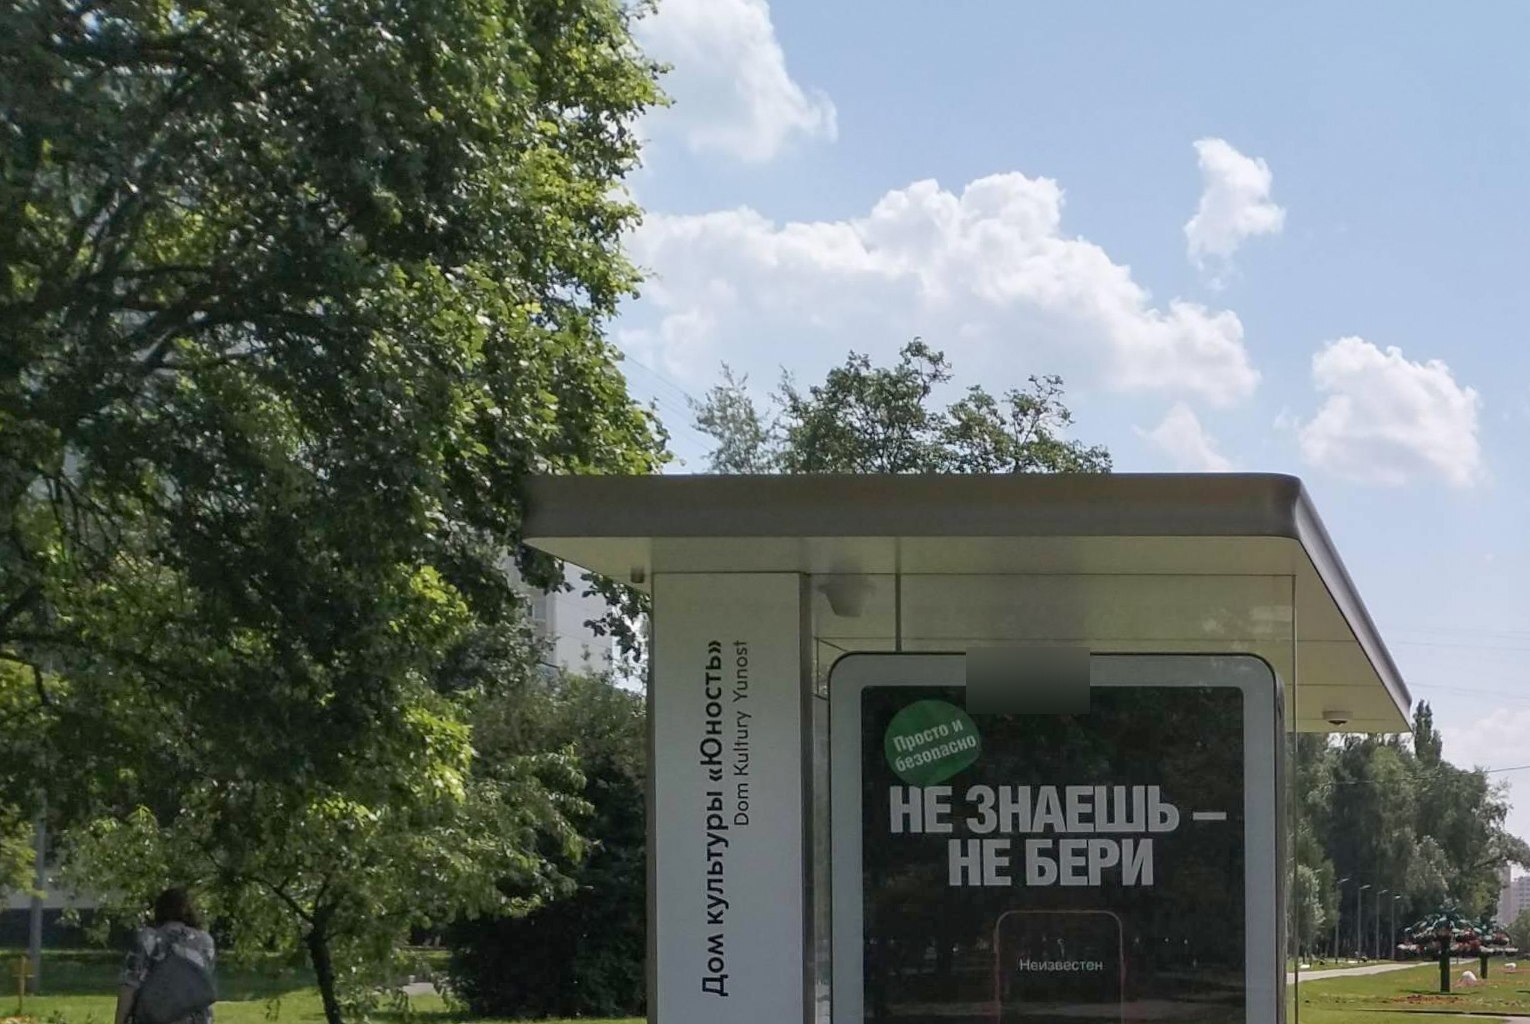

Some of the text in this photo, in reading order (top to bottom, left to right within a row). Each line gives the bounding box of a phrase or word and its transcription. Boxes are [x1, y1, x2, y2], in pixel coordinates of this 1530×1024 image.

[733, 639, 752, 826] Dom Kultury Yunost
[893, 719, 964, 752] Просто и
[895, 735, 977, 772] безопасно
[700, 640, 730, 997] Дом культуры «Юность»
[889, 785, 953, 834] НЕ
[965, 784, 1180, 834] ЗНАЕШЬ
[948, 839, 1154, 887] НЕ БЕРИ
[1019, 958, 1104, 972] Неизвестен
